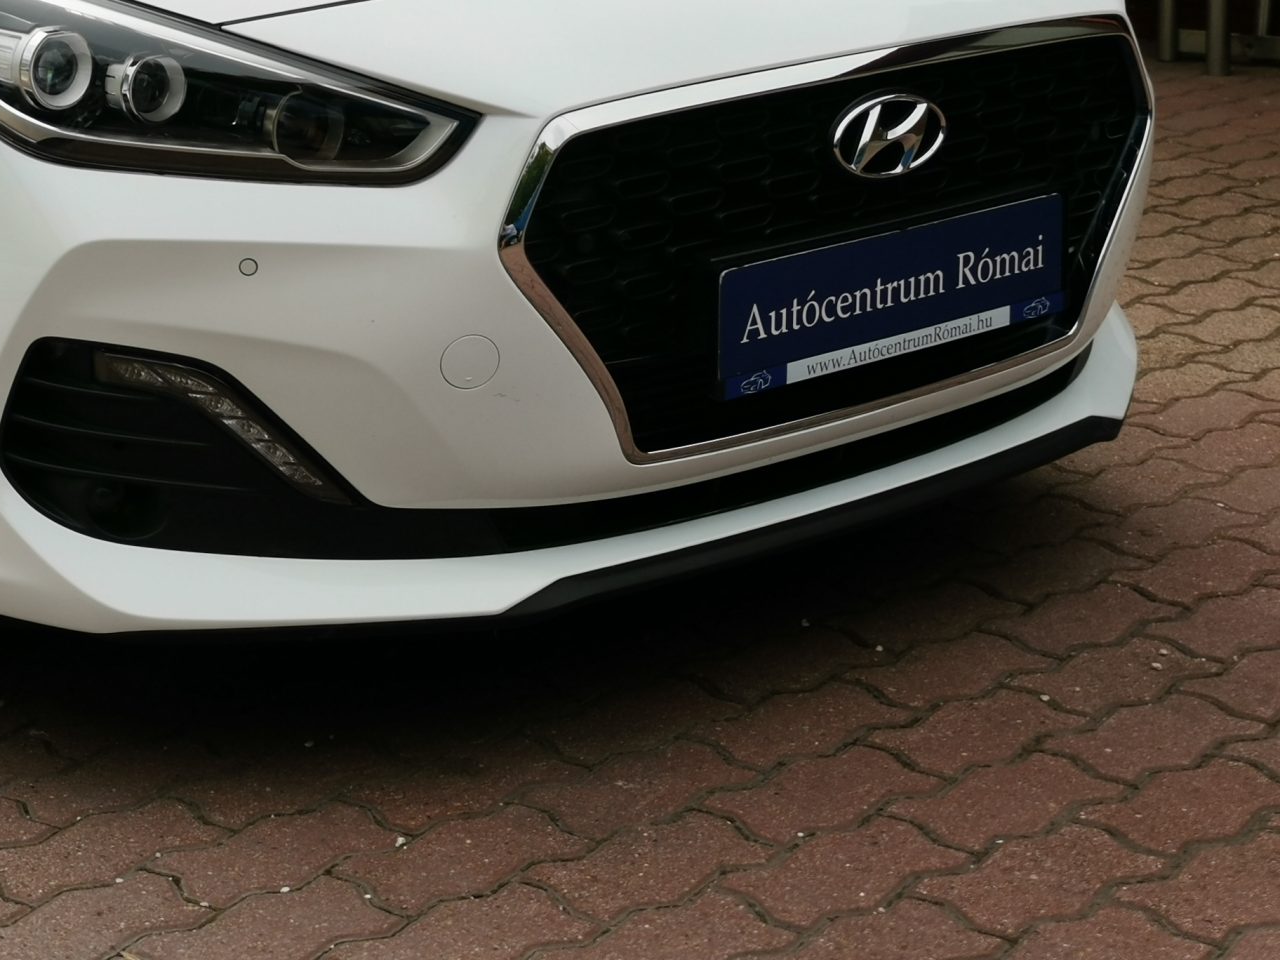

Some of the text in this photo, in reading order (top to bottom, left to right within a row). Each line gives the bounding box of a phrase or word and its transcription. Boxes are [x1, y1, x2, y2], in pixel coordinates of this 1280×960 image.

[740, 234, 1045, 344] Autócentrum Római
[805, 314, 993, 378] www.AutócentrumRómai.hu
